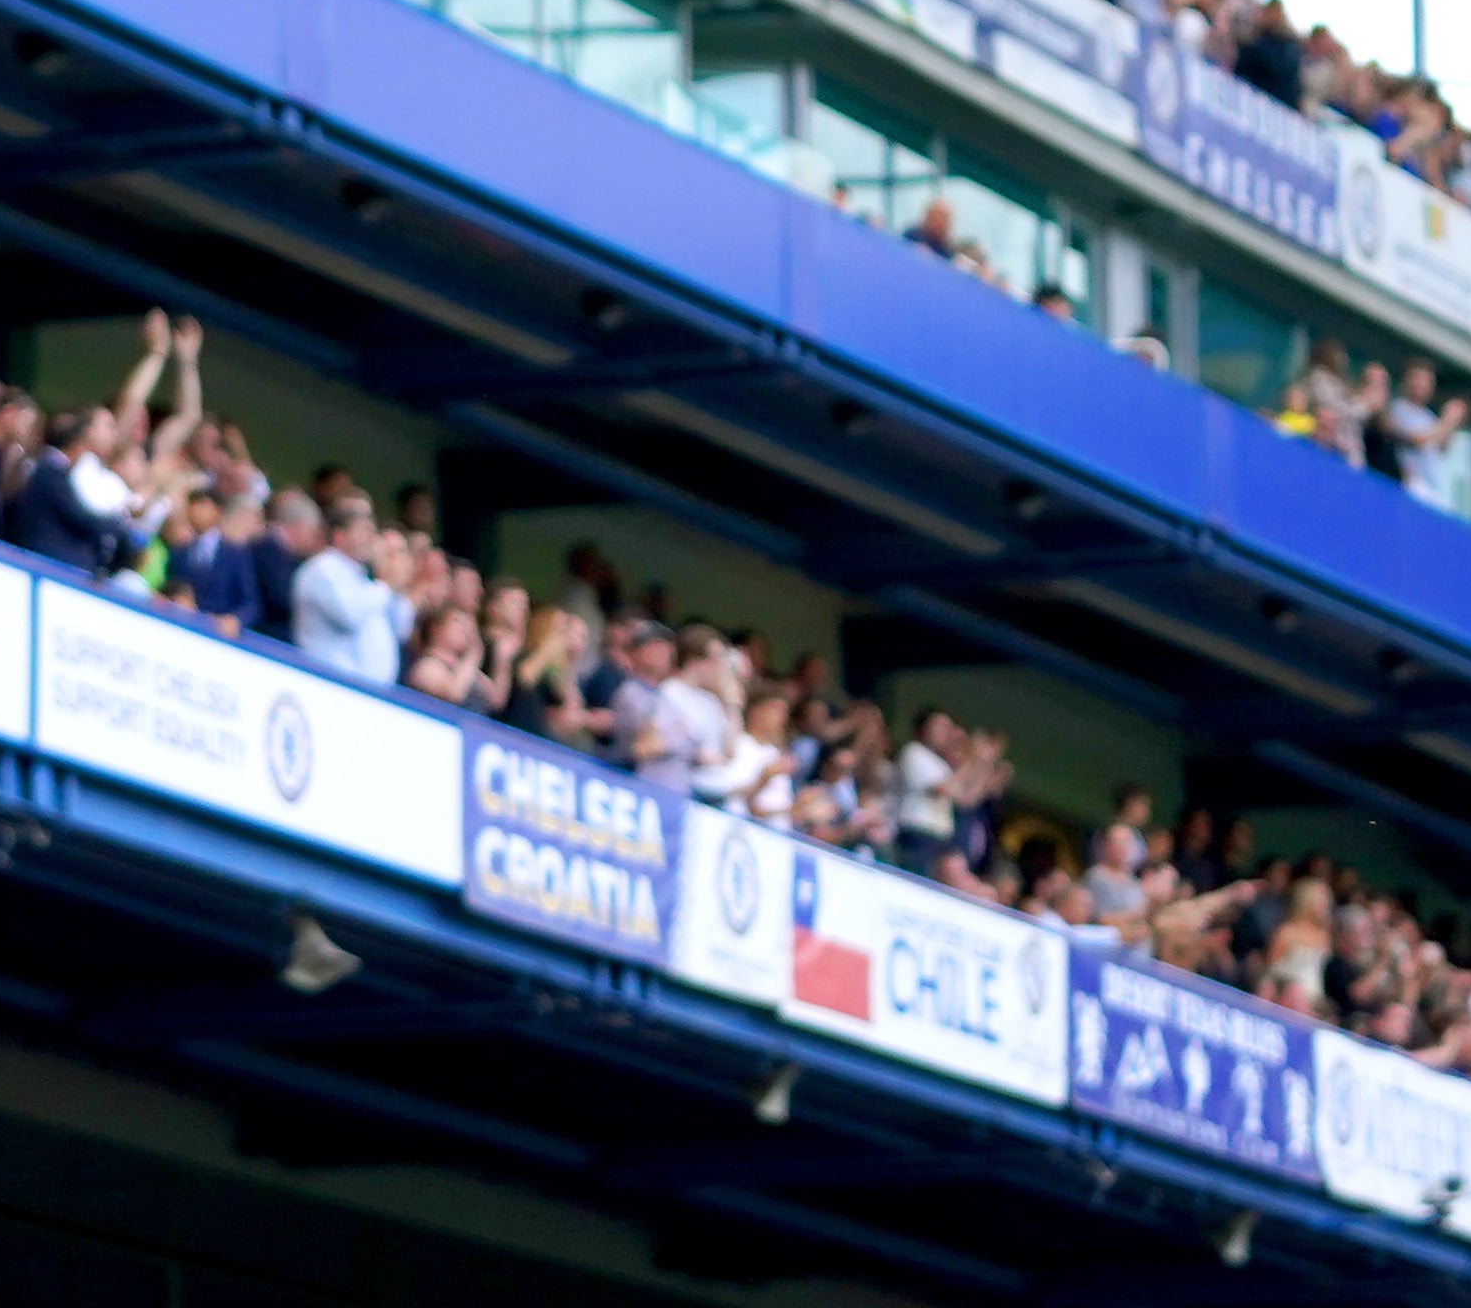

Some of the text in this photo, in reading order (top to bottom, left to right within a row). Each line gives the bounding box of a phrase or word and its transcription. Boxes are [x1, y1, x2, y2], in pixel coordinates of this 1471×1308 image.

[54, 625, 147, 688] SUPPORT
[54, 672, 148, 734] SUPPORT
[475, 742, 666, 868] CHELSEA
[475, 825, 661, 942] CROATIA
[886, 936, 1000, 1044] CHILE
